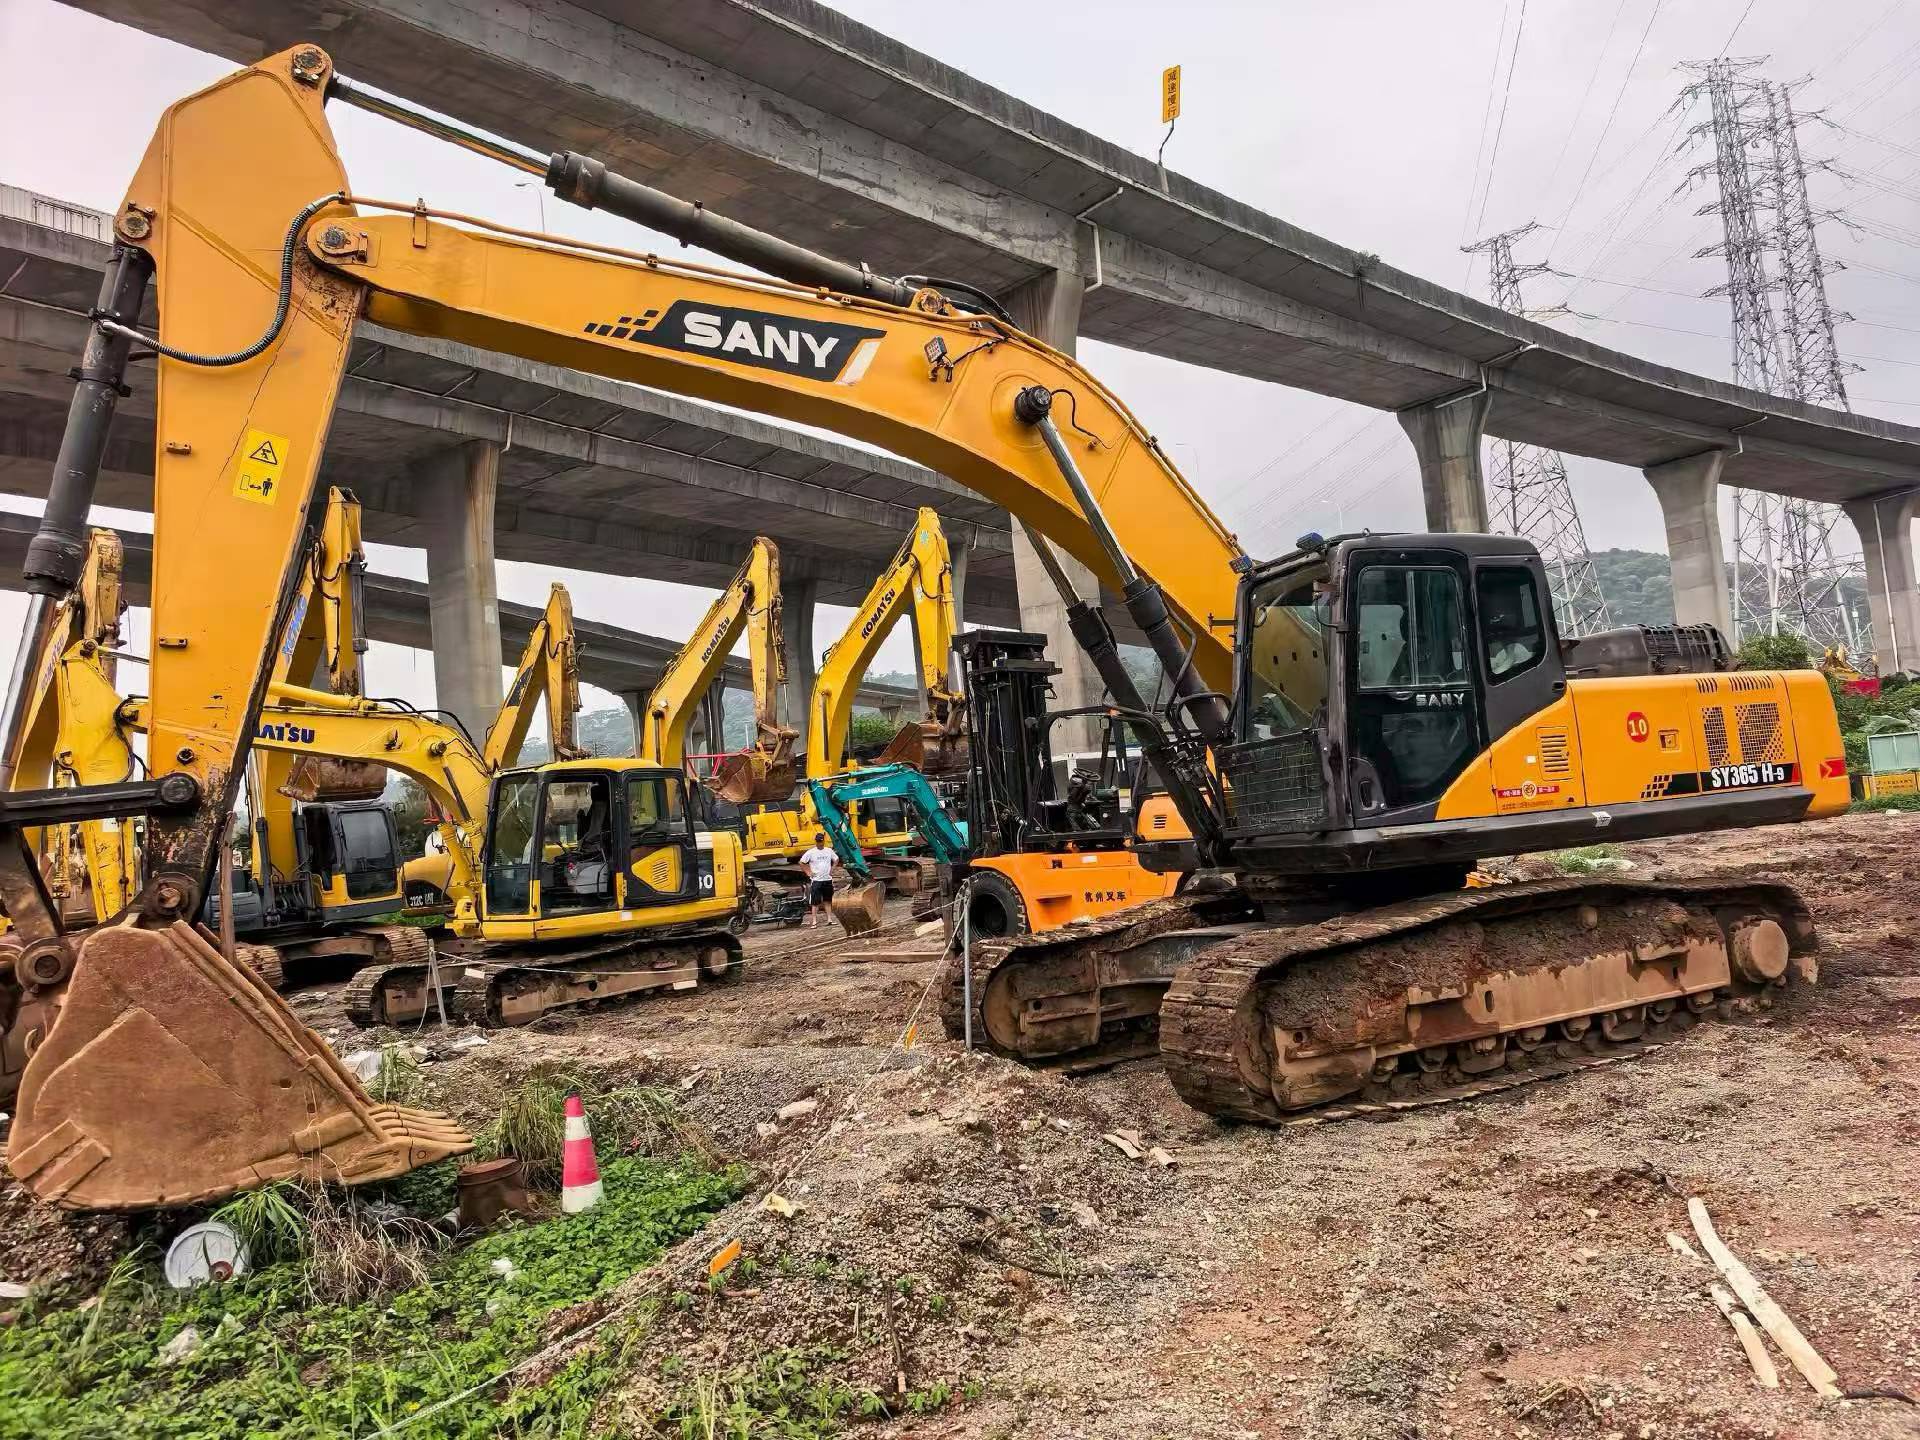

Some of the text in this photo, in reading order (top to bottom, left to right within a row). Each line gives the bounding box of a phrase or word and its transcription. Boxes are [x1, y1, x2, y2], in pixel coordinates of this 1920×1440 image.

[683, 311, 839, 368] SANY
[861, 588, 896, 640] KOMATSU
[701, 616, 731, 663] KOMATSU
[1415, 692, 1465, 707] SANY
[1628, 718, 1648, 737] 10
[1711, 764, 1759, 788] SY365
[1084, 891, 1127, 903] 杭州叉车
